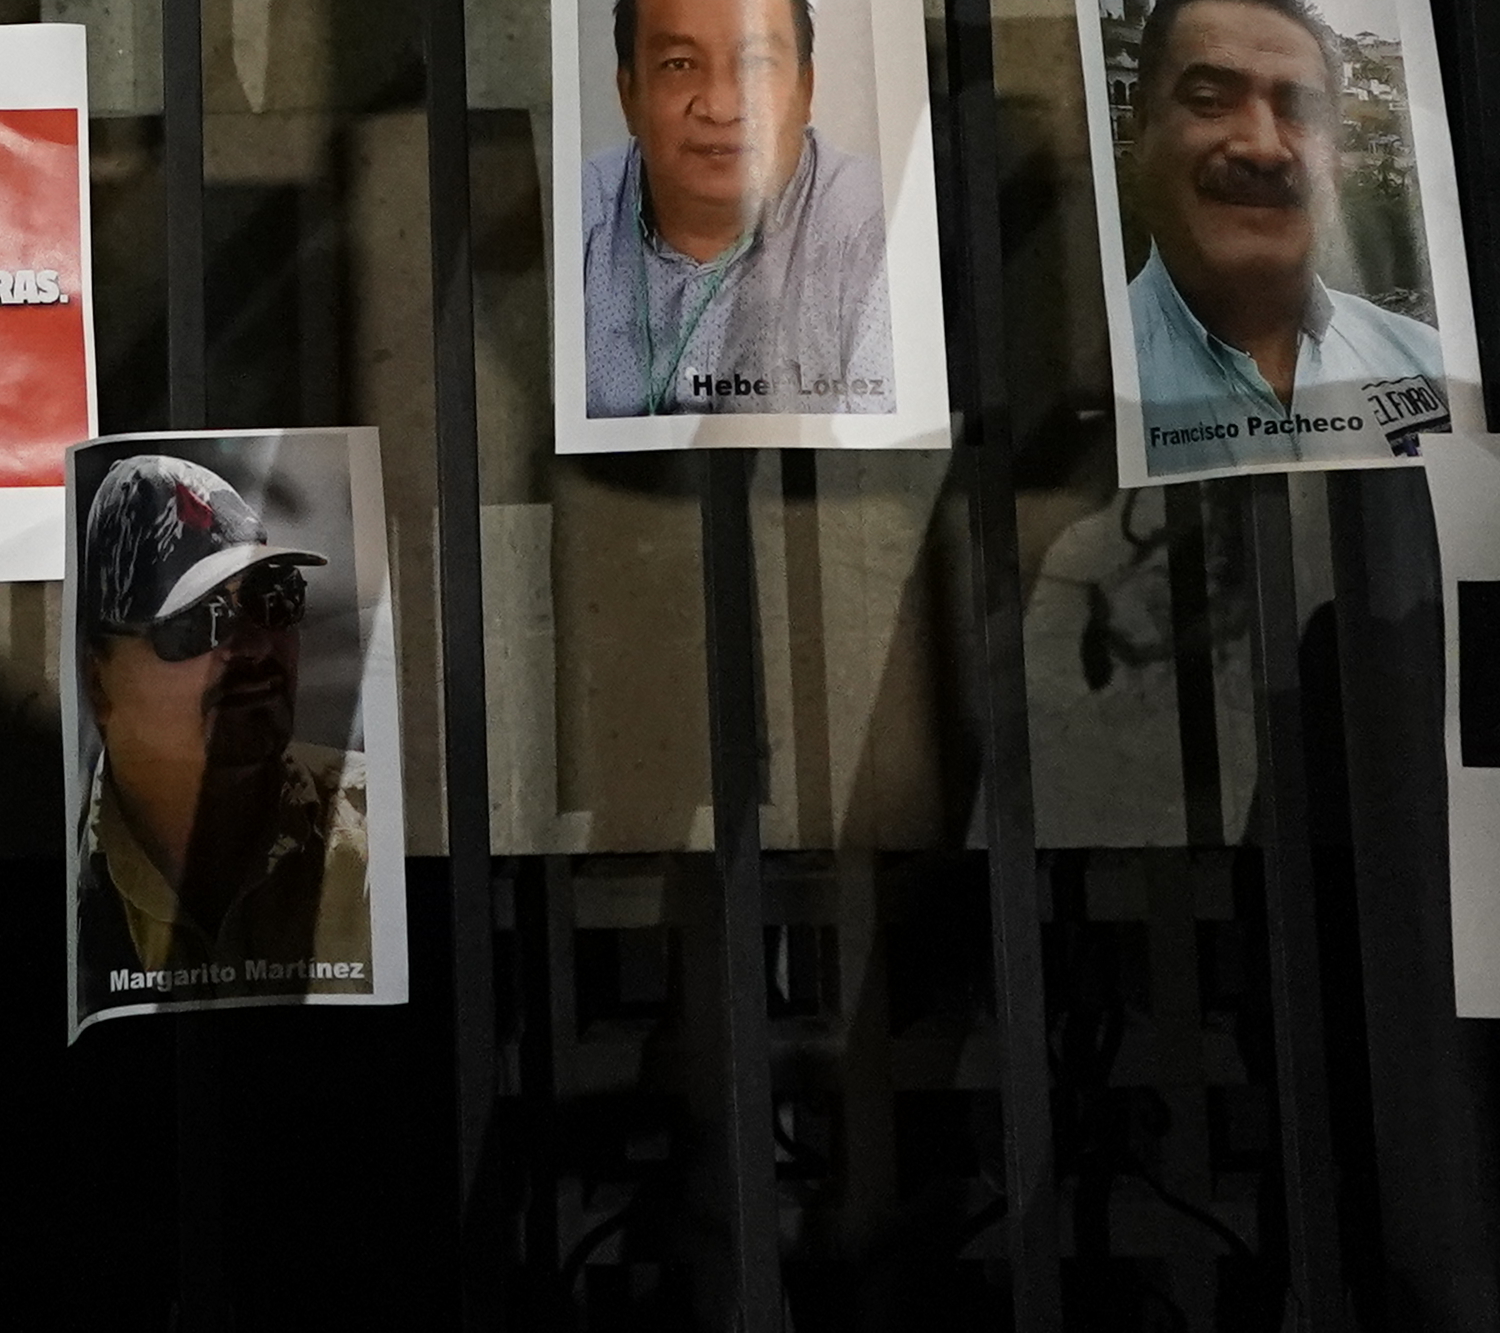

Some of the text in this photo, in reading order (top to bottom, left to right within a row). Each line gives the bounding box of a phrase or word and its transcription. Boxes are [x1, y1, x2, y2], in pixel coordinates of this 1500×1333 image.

[693, 374, 784, 396] Hebe
[1151, 414, 1364, 449] Francisco Pacheco
[110, 956, 367, 993] Margarito Martínez
